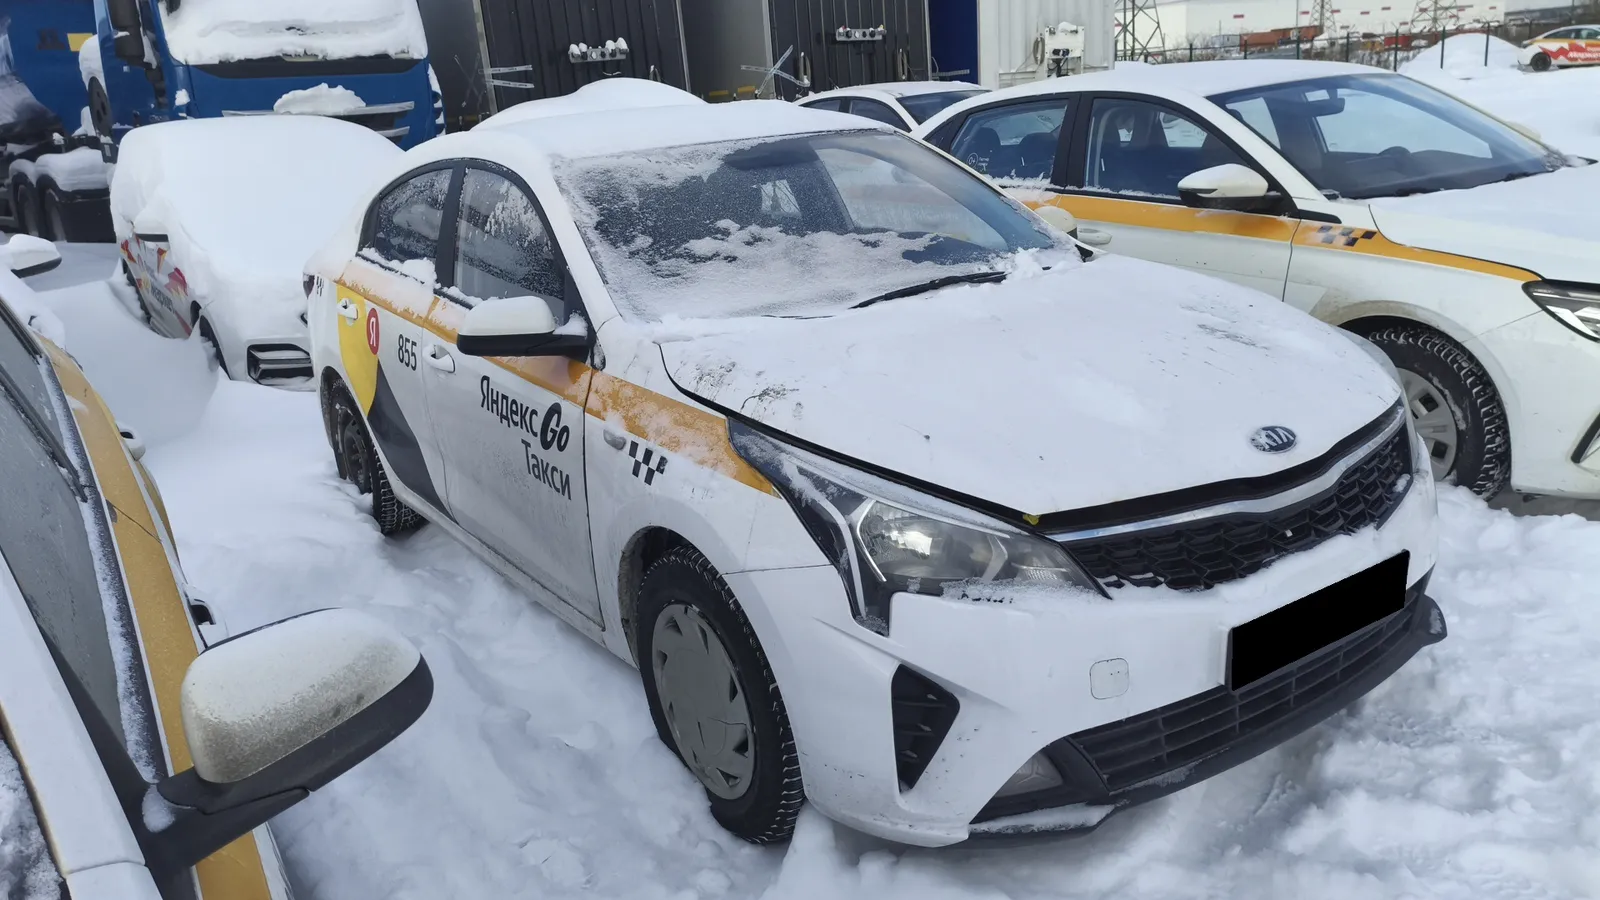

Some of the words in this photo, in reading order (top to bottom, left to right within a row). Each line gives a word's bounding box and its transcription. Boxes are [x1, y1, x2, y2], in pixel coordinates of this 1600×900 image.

[369, 317, 376, 347] Я
[397, 334, 417, 371] 855
[480, 375, 539, 438] Яндекс
[540, 402, 570, 452] Go
[1257, 427, 1295, 450] KIA
[521, 438, 571, 500] Такси
